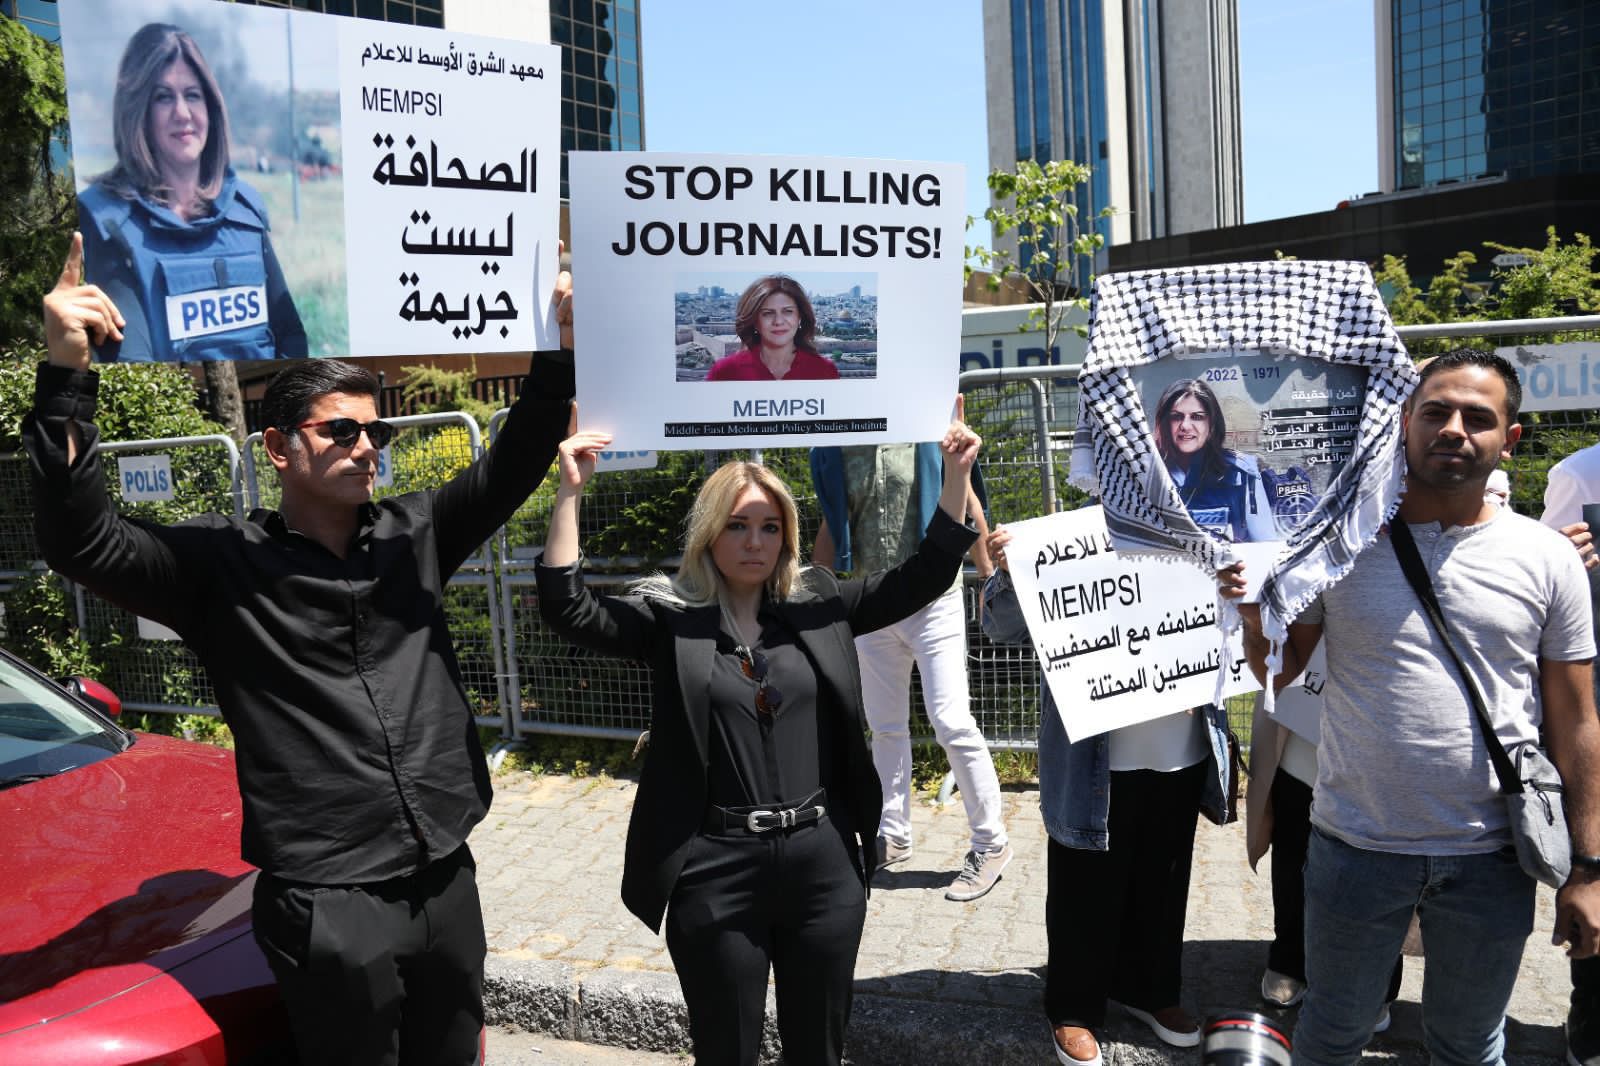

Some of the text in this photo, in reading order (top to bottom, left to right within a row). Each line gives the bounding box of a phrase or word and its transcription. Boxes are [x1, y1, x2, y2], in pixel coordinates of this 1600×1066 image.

[361, 41, 544, 82] معهد الشرق الأوسط للاعلام
[362, 86, 442, 117] MEMPSI
[373, 132, 536, 193] الصحافة
[624, 165, 941, 207] STOP KILLING
[401, 209, 513, 276] ليست
[611, 221, 941, 259] JOURNALISTS!
[181, 290, 260, 332] PRESS
[399, 272, 519, 340] جريمة
[1206, 369, 1238, 382] 2022
[1253, 367, 1280, 380] 1971
[733, 398, 825, 417] MEMPSI
[665, 421, 887, 436] Middle East Media and Policy Studies Institute
[125, 465, 169, 492] POLİS
[1278, 484, 1309, 496] PRESS
[1034, 533, 1098, 579] للاعلام
[1038, 572, 1142, 623] MEMPSI
[1040, 624, 1121, 673] الصحفيين
[1126, 625, 1151, 656] مع
[1087, 666, 1148, 702] المحتلة
